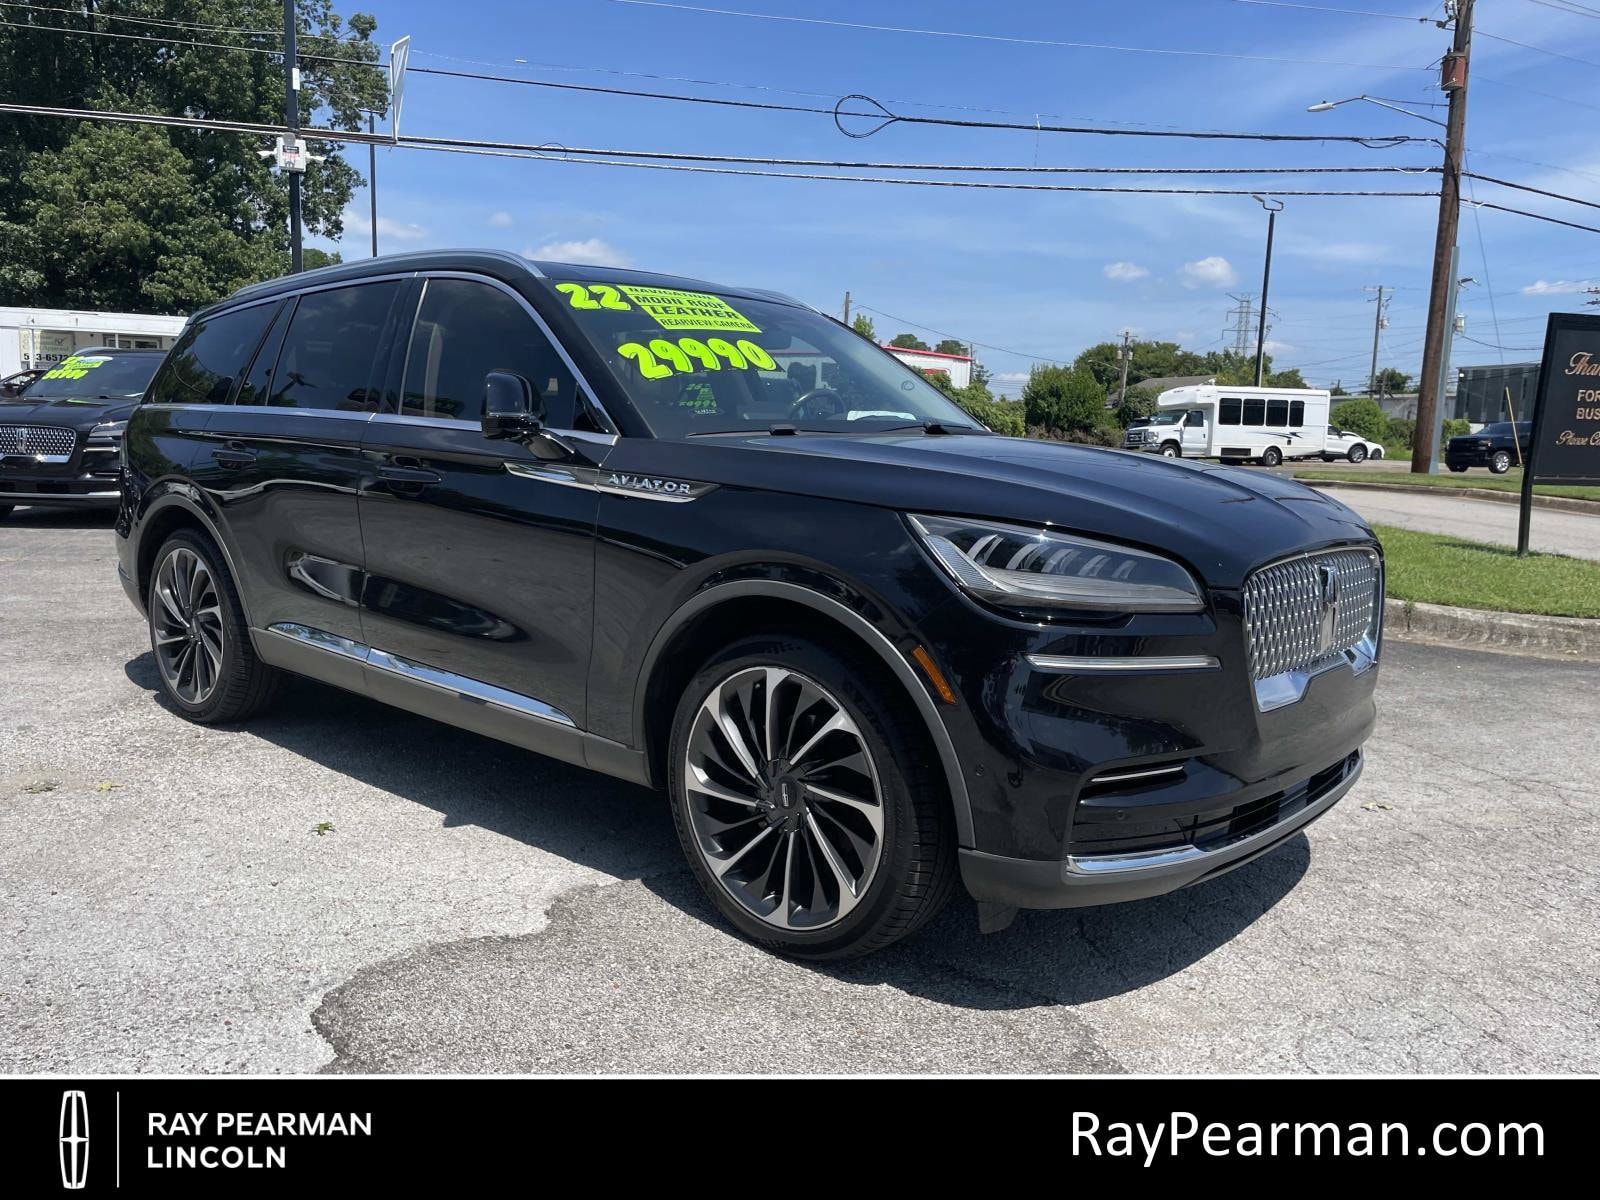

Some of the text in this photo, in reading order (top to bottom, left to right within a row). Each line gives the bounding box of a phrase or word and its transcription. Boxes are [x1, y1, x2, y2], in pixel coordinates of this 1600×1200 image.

[555, 283, 631, 311] 22
[635, 295, 726, 309] MOON ROOF
[650, 306, 739, 320] LEATHER
[659, 318, 755, 329] REARVIEW CAMERA
[617, 337, 777, 382] 29990
[1577, 389, 1600, 402] FOR
[608, 473, 691, 495] AVIATOR
